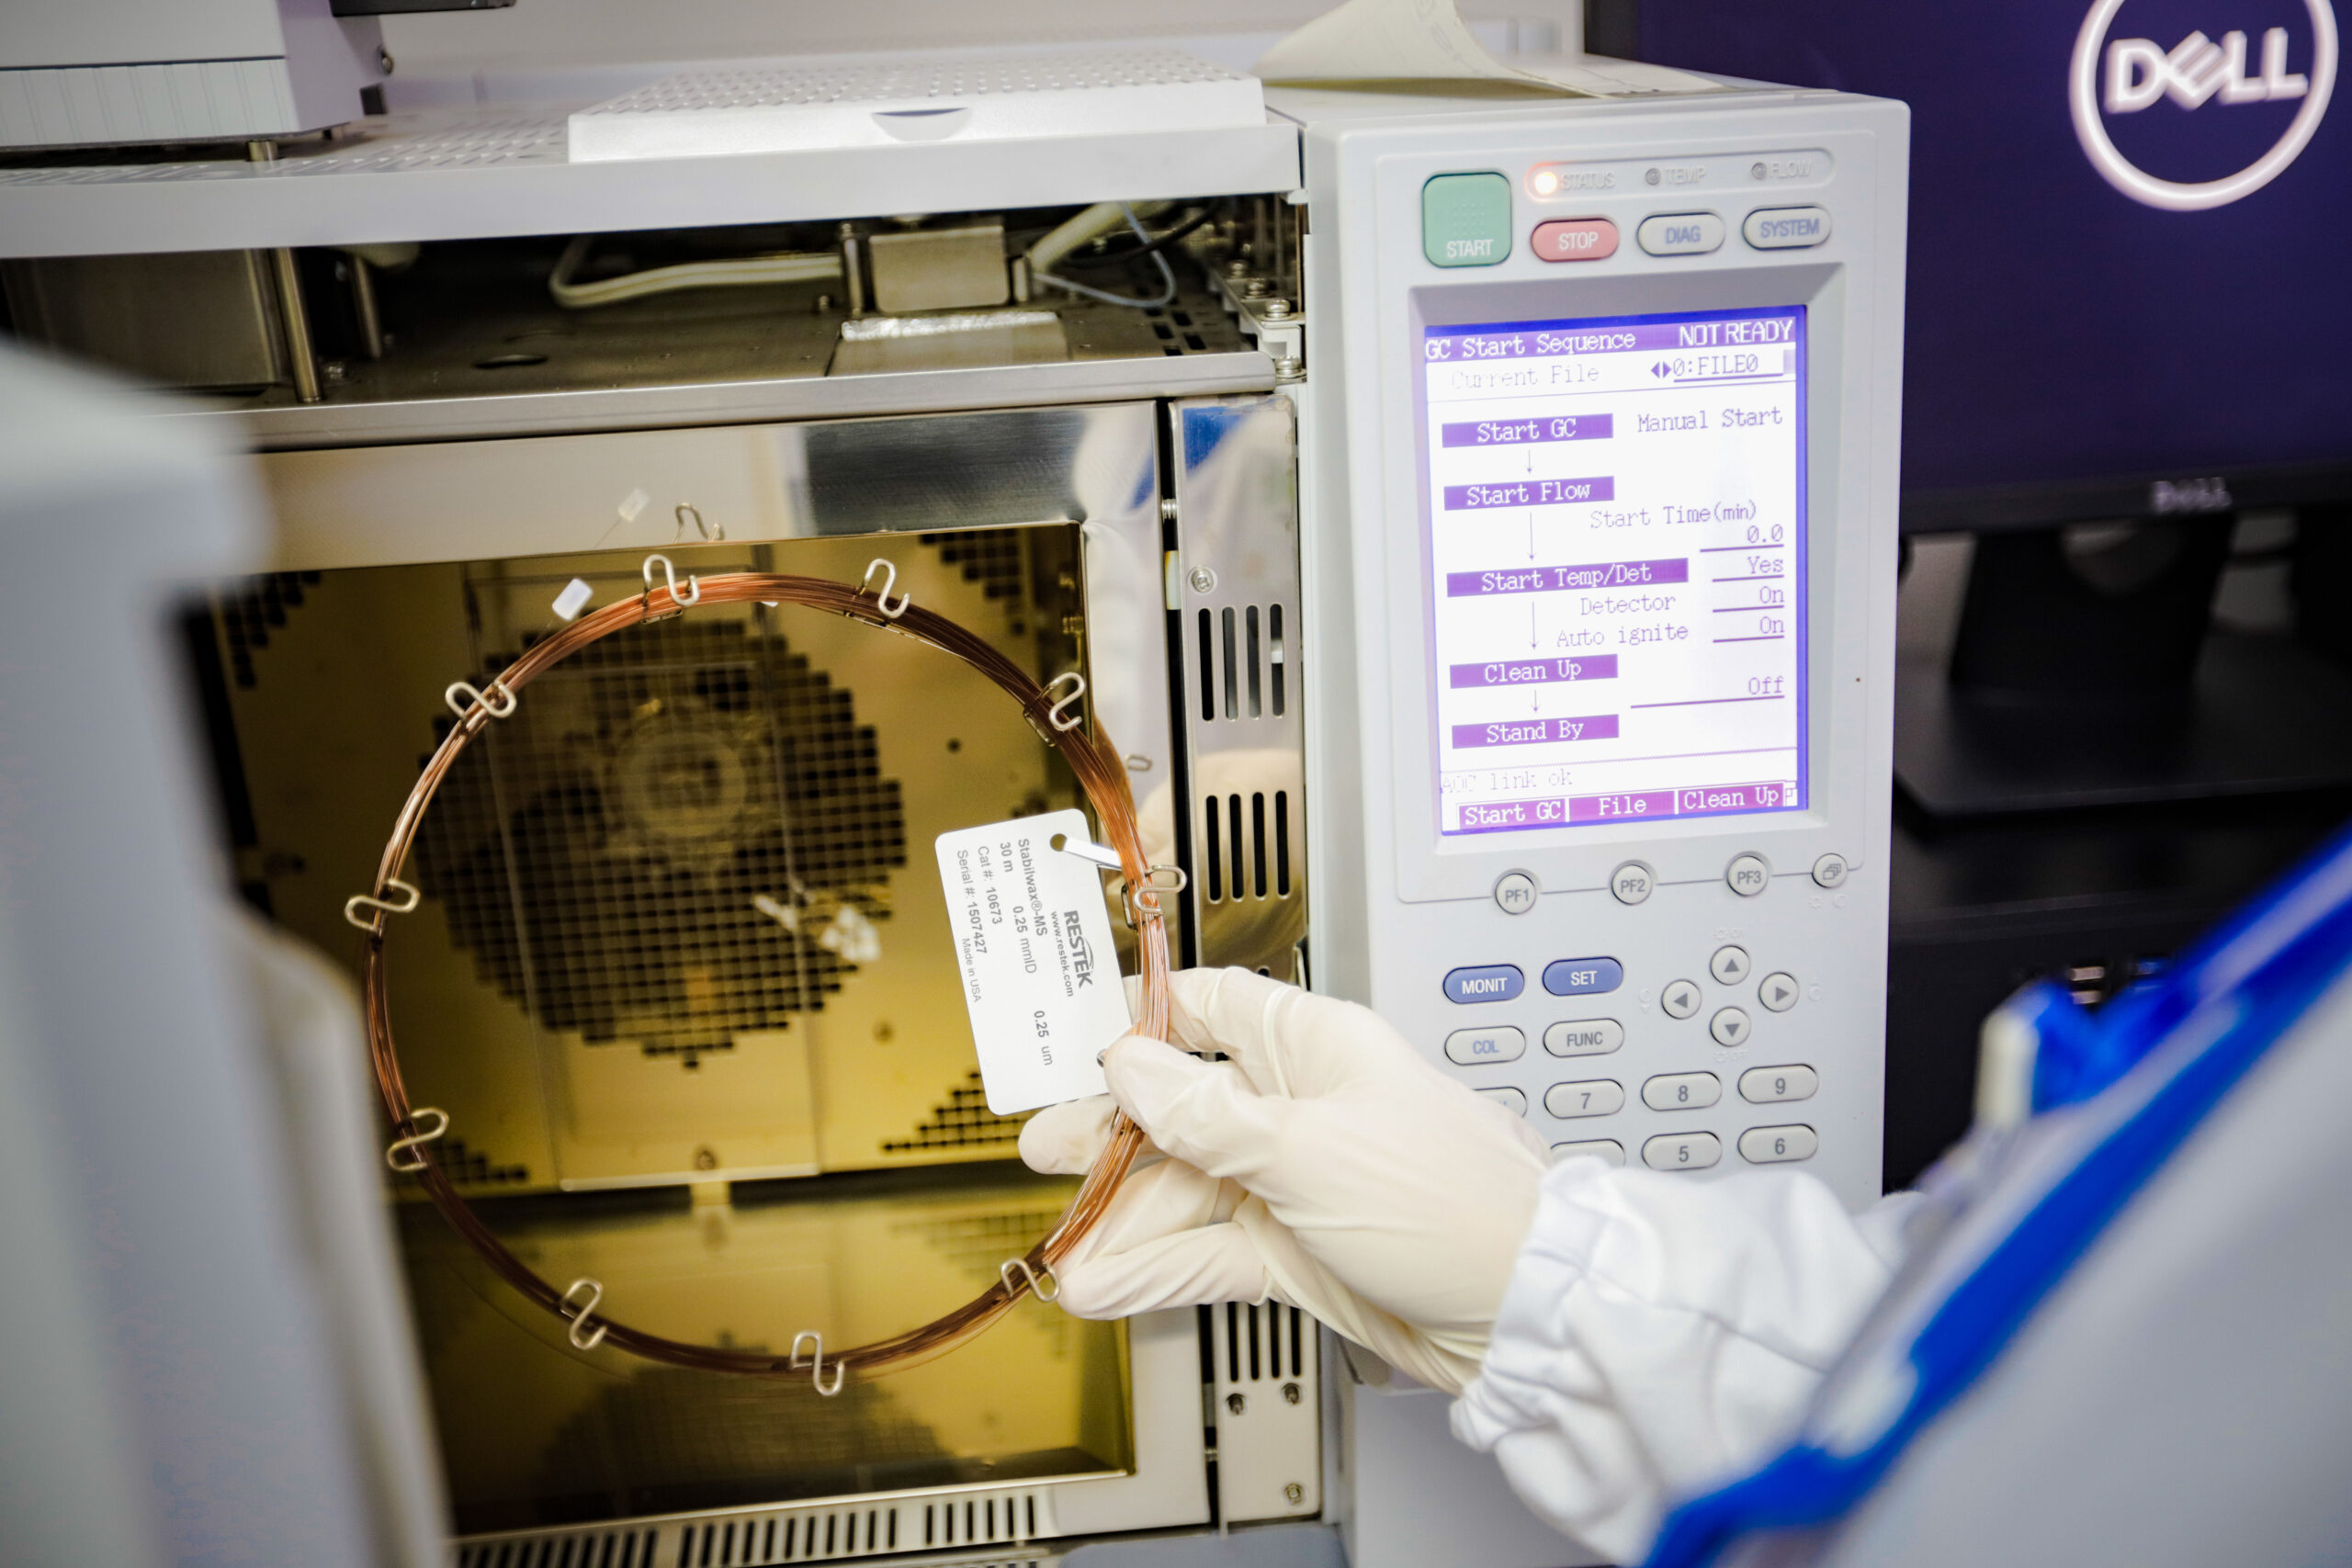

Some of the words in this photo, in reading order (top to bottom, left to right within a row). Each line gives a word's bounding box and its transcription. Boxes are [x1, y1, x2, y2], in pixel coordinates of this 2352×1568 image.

[2106, 28, 2309, 114] DELL
[1664, 166, 1706, 184] TEMP
[1770, 159, 1814, 178] FLOW
[1561, 171, 1615, 188] STATUS
[1666, 226, 1702, 243] DIAG
[1759, 219, 1820, 237] SYSTEM
[1446, 239, 1494, 258] START
[1558, 231, 1599, 250] STOP
[1679, 324, 1720, 346] NOT
[1725, 321, 1792, 344] READY
[1426, 338, 1451, 358] GC
[1462, 335, 1525, 356] Start
[1537, 331, 1636, 354] Sequence
[1452, 366, 1538, 389] Current
[1551, 363, 1600, 383] File
[1638, 410, 1708, 433] Manual
[1722, 406, 1783, 428] Start
[1477, 421, 1539, 443] Start
[1551, 418, 1577, 438] GC
[1467, 483, 1529, 505] Start
[1541, 480, 1590, 502] Flow
[1589, 508, 1651, 529] Start
[1663, 500, 1757, 525] Time(min)
[1747, 525, 1783, 544] 0.0
[1747, 556, 1784, 575] Yes
[1482, 570, 1544, 592] Start
[1555, 564, 1652, 590] Temp/Det
[1580, 592, 1676, 616] Detector
[1758, 586, 1784, 605] On
[1556, 628, 1605, 648] Auto
[1618, 623, 1689, 646] ignite
[1758, 616, 1784, 635] On
[1485, 661, 1546, 682] Clean
[1558, 660, 1581, 681] Up
[1747, 675, 1784, 694] Off
[1487, 722, 1546, 744] Stand
[1559, 721, 1584, 742] By
[1490, 772, 1536, 791] link
[1548, 769, 1573, 786] ok
[1599, 795, 1646, 816] File
[1684, 789, 1745, 809] Clean
[1755, 787, 1779, 808] Up
[1464, 804, 1524, 826] Start
[1536, 801, 1561, 820] GC
[1000, 841, 1012, 857] 30
[957, 850, 975, 885] Serial
[1002, 860, 1013, 873] m
[978, 845, 990, 867] Cat
[986, 886, 1003, 925] 10673
[1620, 878, 1645, 895] PF2
[1736, 870, 1762, 886] PF3
[1505, 888, 1530, 904] PF1
[967, 901, 988, 954] 1507427
[1012, 906, 1029, 933] 0.25
[962, 938, 975, 966] Made
[1050, 910, 1074, 998] www.restek.com
[1064, 910, 1093, 988] RESTEK
[967, 968, 975, 976] in
[1570, 970, 1597, 987] SET
[969, 978, 982, 1003] USA
[1461, 976, 1508, 995] MONIT
[1034, 1010, 1050, 1038] 0.25
[1472, 1040, 1499, 1055] COL
[1566, 1031, 1603, 1047] FUNC
[1041, 1045, 1054, 1066] um
[1678, 1086, 1689, 1103] 8
[1775, 1077, 1786, 1095] 9
[1580, 1093, 1591, 1110] 7
[1679, 1145, 1690, 1164] 5
[1775, 1138, 1786, 1156] 6
